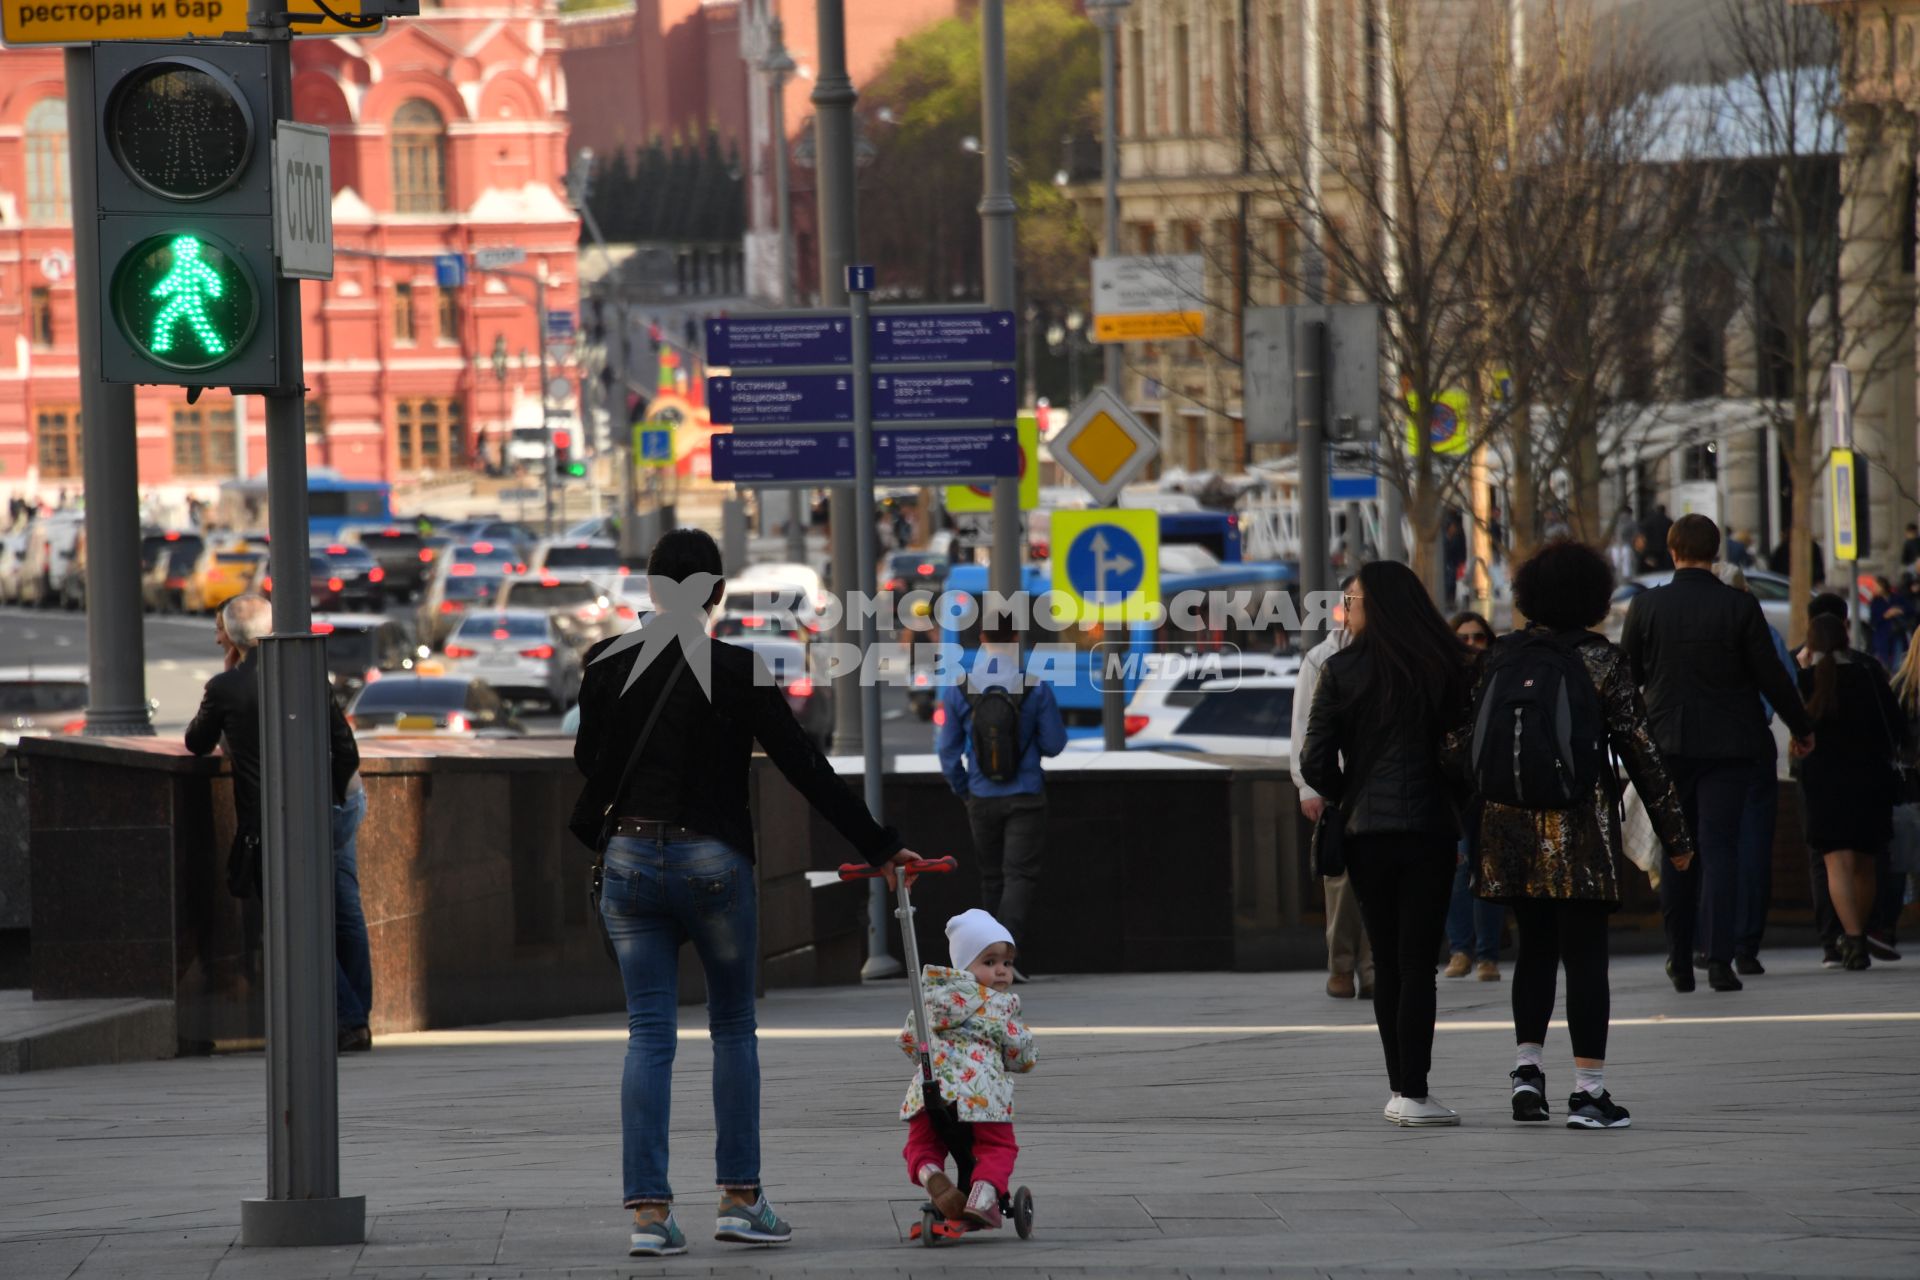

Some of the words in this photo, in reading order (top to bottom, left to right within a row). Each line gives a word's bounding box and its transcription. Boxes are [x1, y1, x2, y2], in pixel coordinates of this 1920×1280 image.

[19, 3, 142, 28] ресторан
[151, 2, 166, 18] и
[174, 0, 222, 22] бар
[286, 159, 326, 244] СТОП
[731, 380, 787, 392] Гостиница
[731, 391, 803, 403] «Националь»
[732, 438, 783, 448] Московский
[785, 438, 818, 449] Кремль
